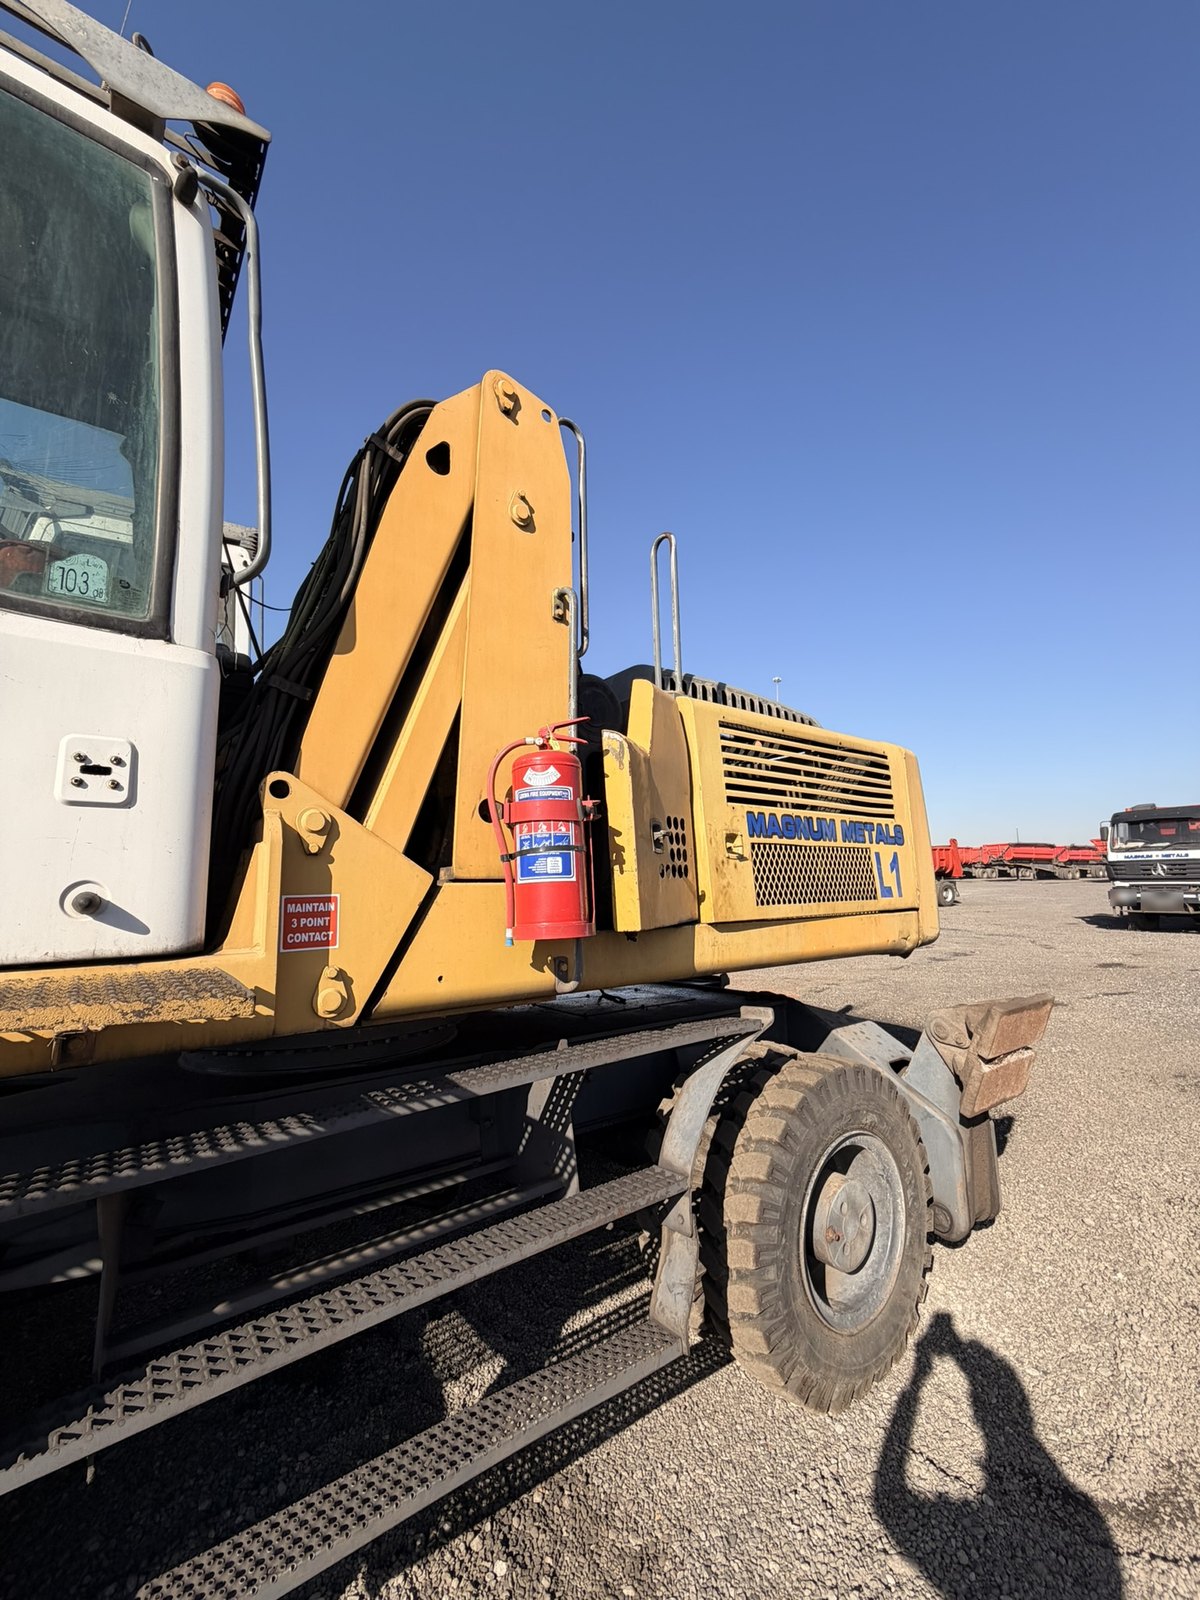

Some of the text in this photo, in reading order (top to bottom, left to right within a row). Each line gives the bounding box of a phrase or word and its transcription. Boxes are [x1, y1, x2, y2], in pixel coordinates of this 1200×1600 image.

[58, 566, 89, 595] 103
[746, 811, 905, 846] MAGNUM METALS
[874, 852, 902, 898] L1
[287, 902, 335, 913] MAINTAIN
[291, 917, 330, 928] 3 POINT
[287, 931, 333, 943] CONTACT
